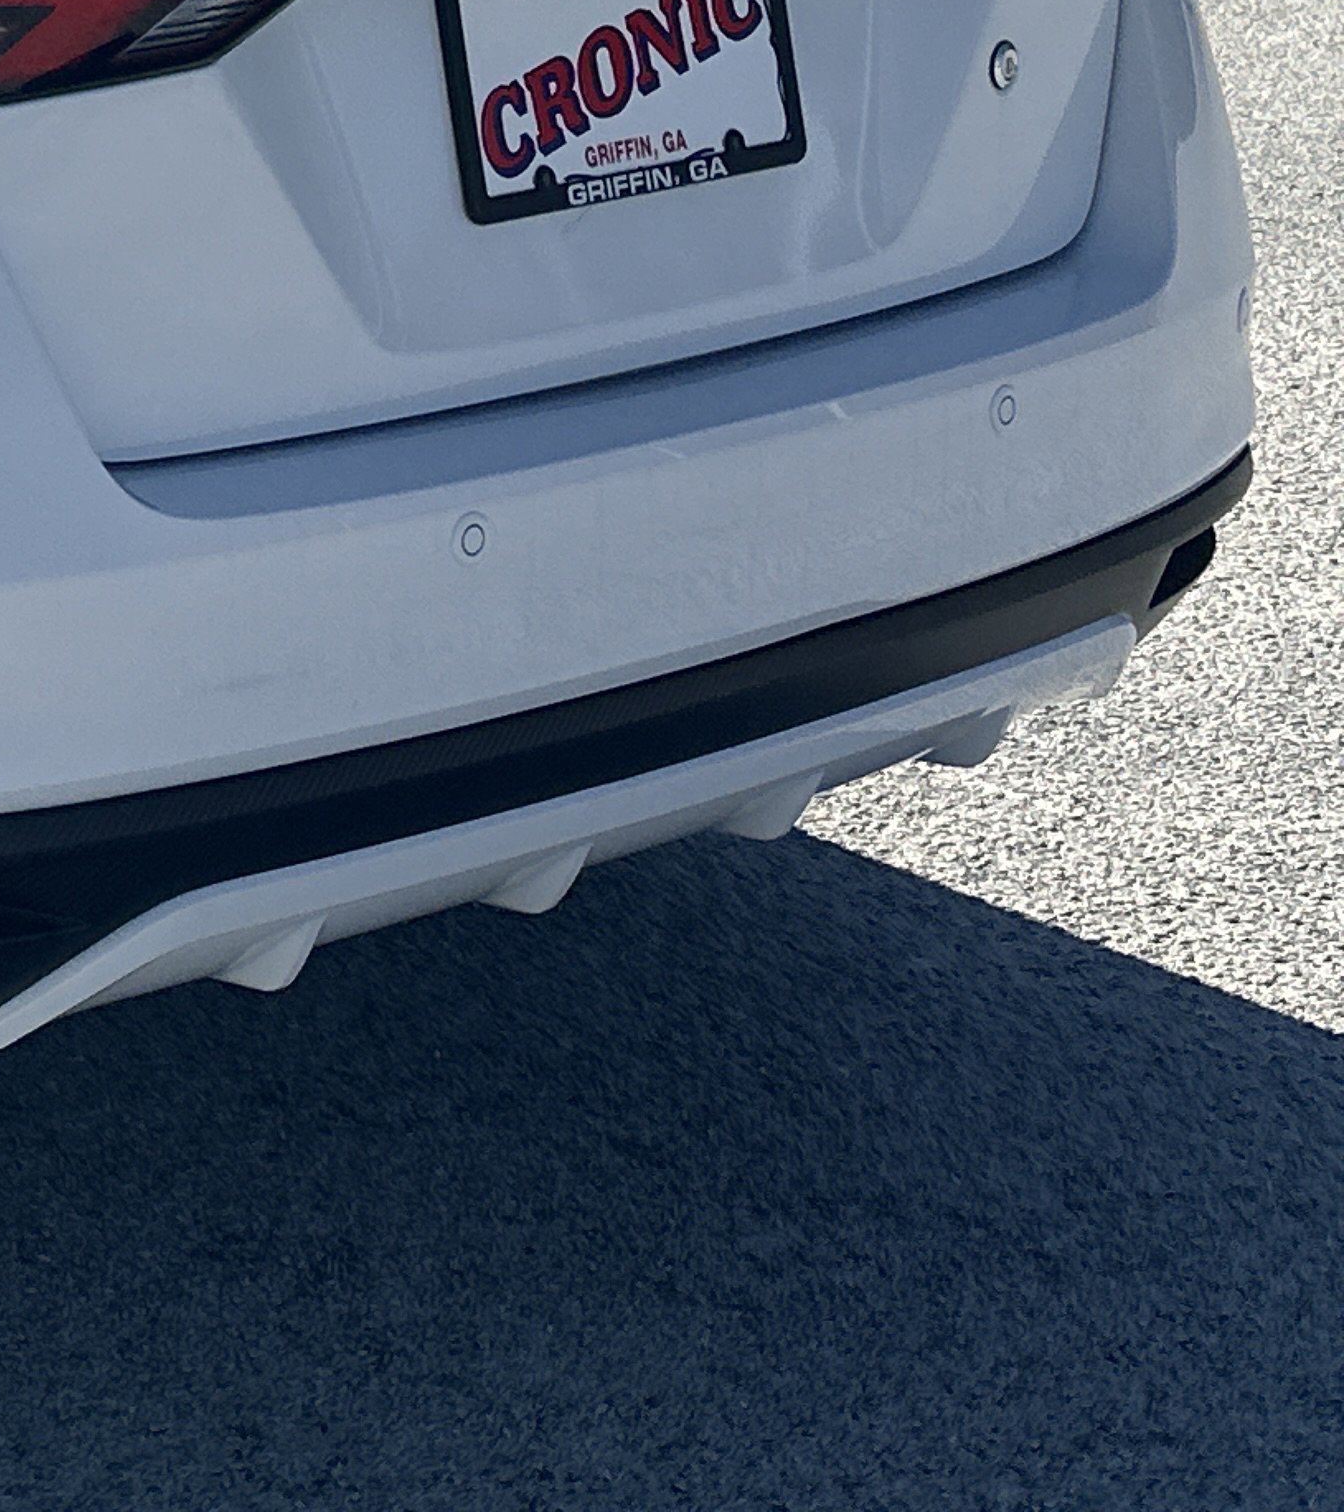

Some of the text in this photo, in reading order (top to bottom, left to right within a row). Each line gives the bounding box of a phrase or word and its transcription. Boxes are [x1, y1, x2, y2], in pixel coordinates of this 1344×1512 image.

[584, 128, 688, 168] GRIFFIN, GA
[567, 155, 730, 206] GRIFFIN, GA
